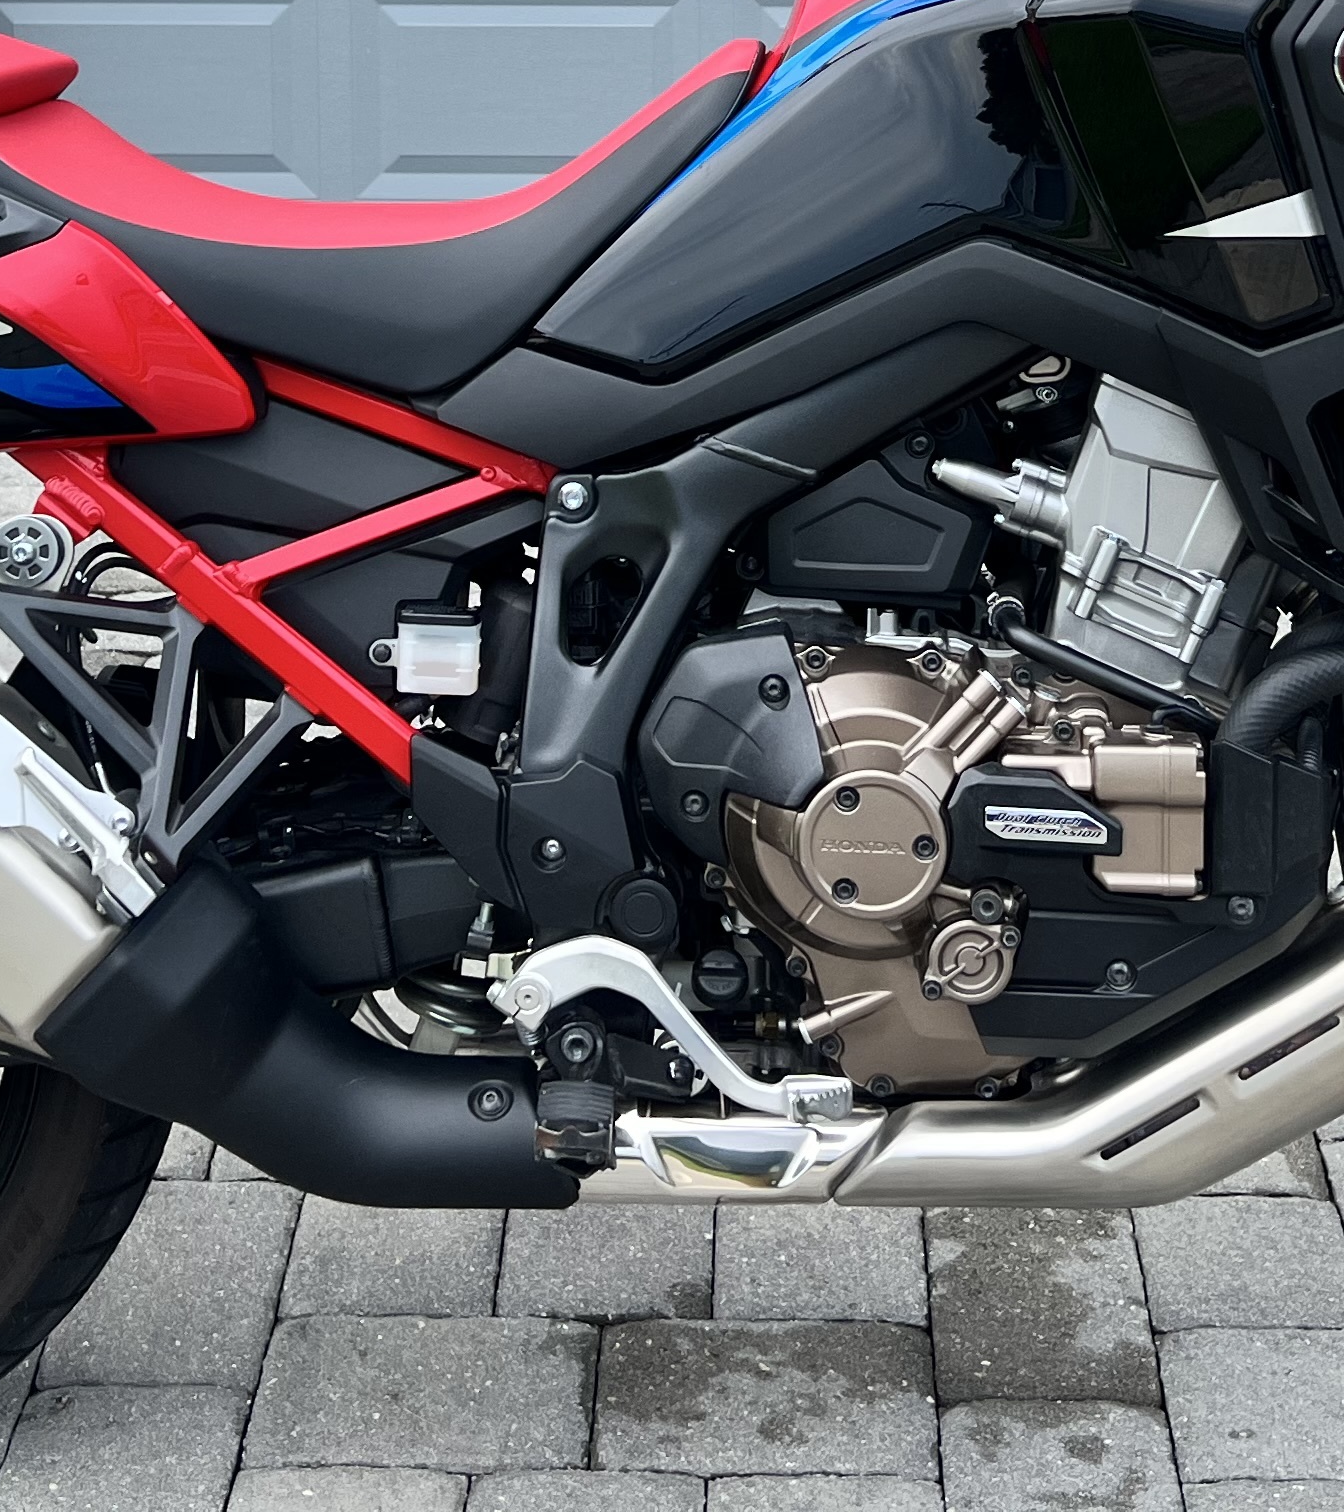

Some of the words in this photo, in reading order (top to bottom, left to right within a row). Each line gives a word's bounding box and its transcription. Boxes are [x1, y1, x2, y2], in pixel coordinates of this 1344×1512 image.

[995, 811, 1032, 825] Dual
[999, 824, 1103, 838] Transmission
[819, 838, 906, 855] HONDA
